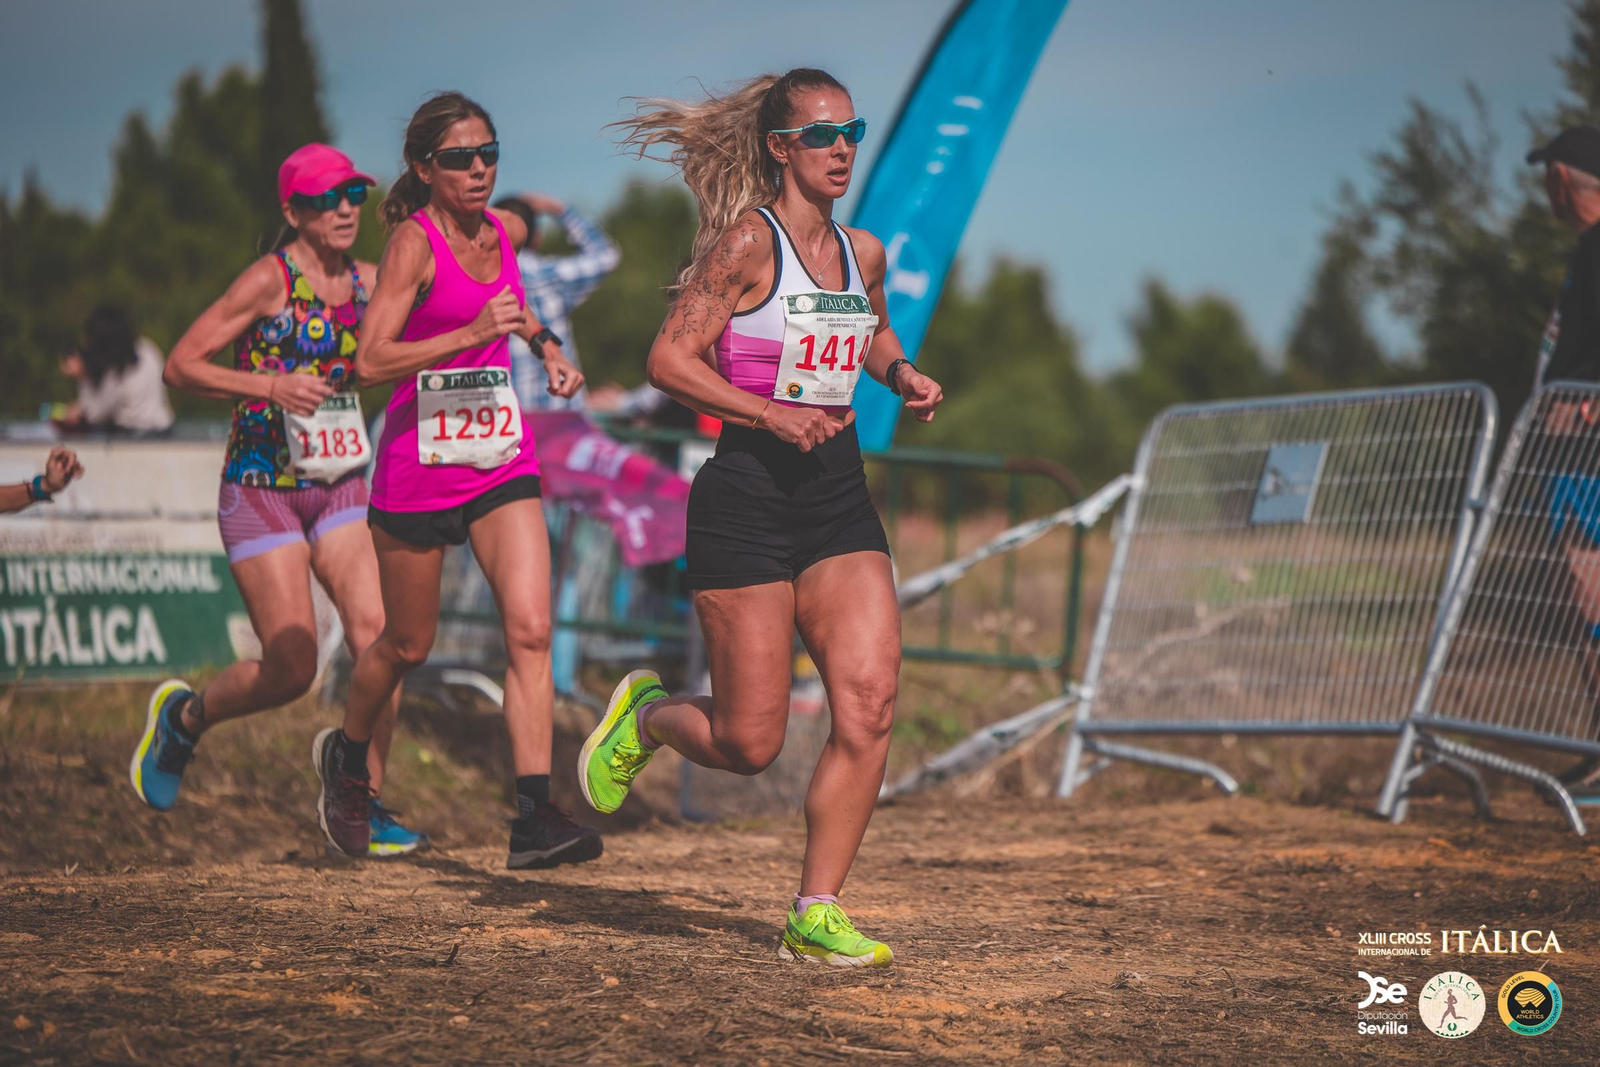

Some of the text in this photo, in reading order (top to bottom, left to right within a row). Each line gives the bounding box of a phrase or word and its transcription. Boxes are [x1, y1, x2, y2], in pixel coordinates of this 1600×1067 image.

[432, 406, 515, 441] 1292
[299, 428, 363, 459] 1183
[6, 558, 221, 597] INTERNACIONAL
[0, 596, 168, 667] ITÁLICA
